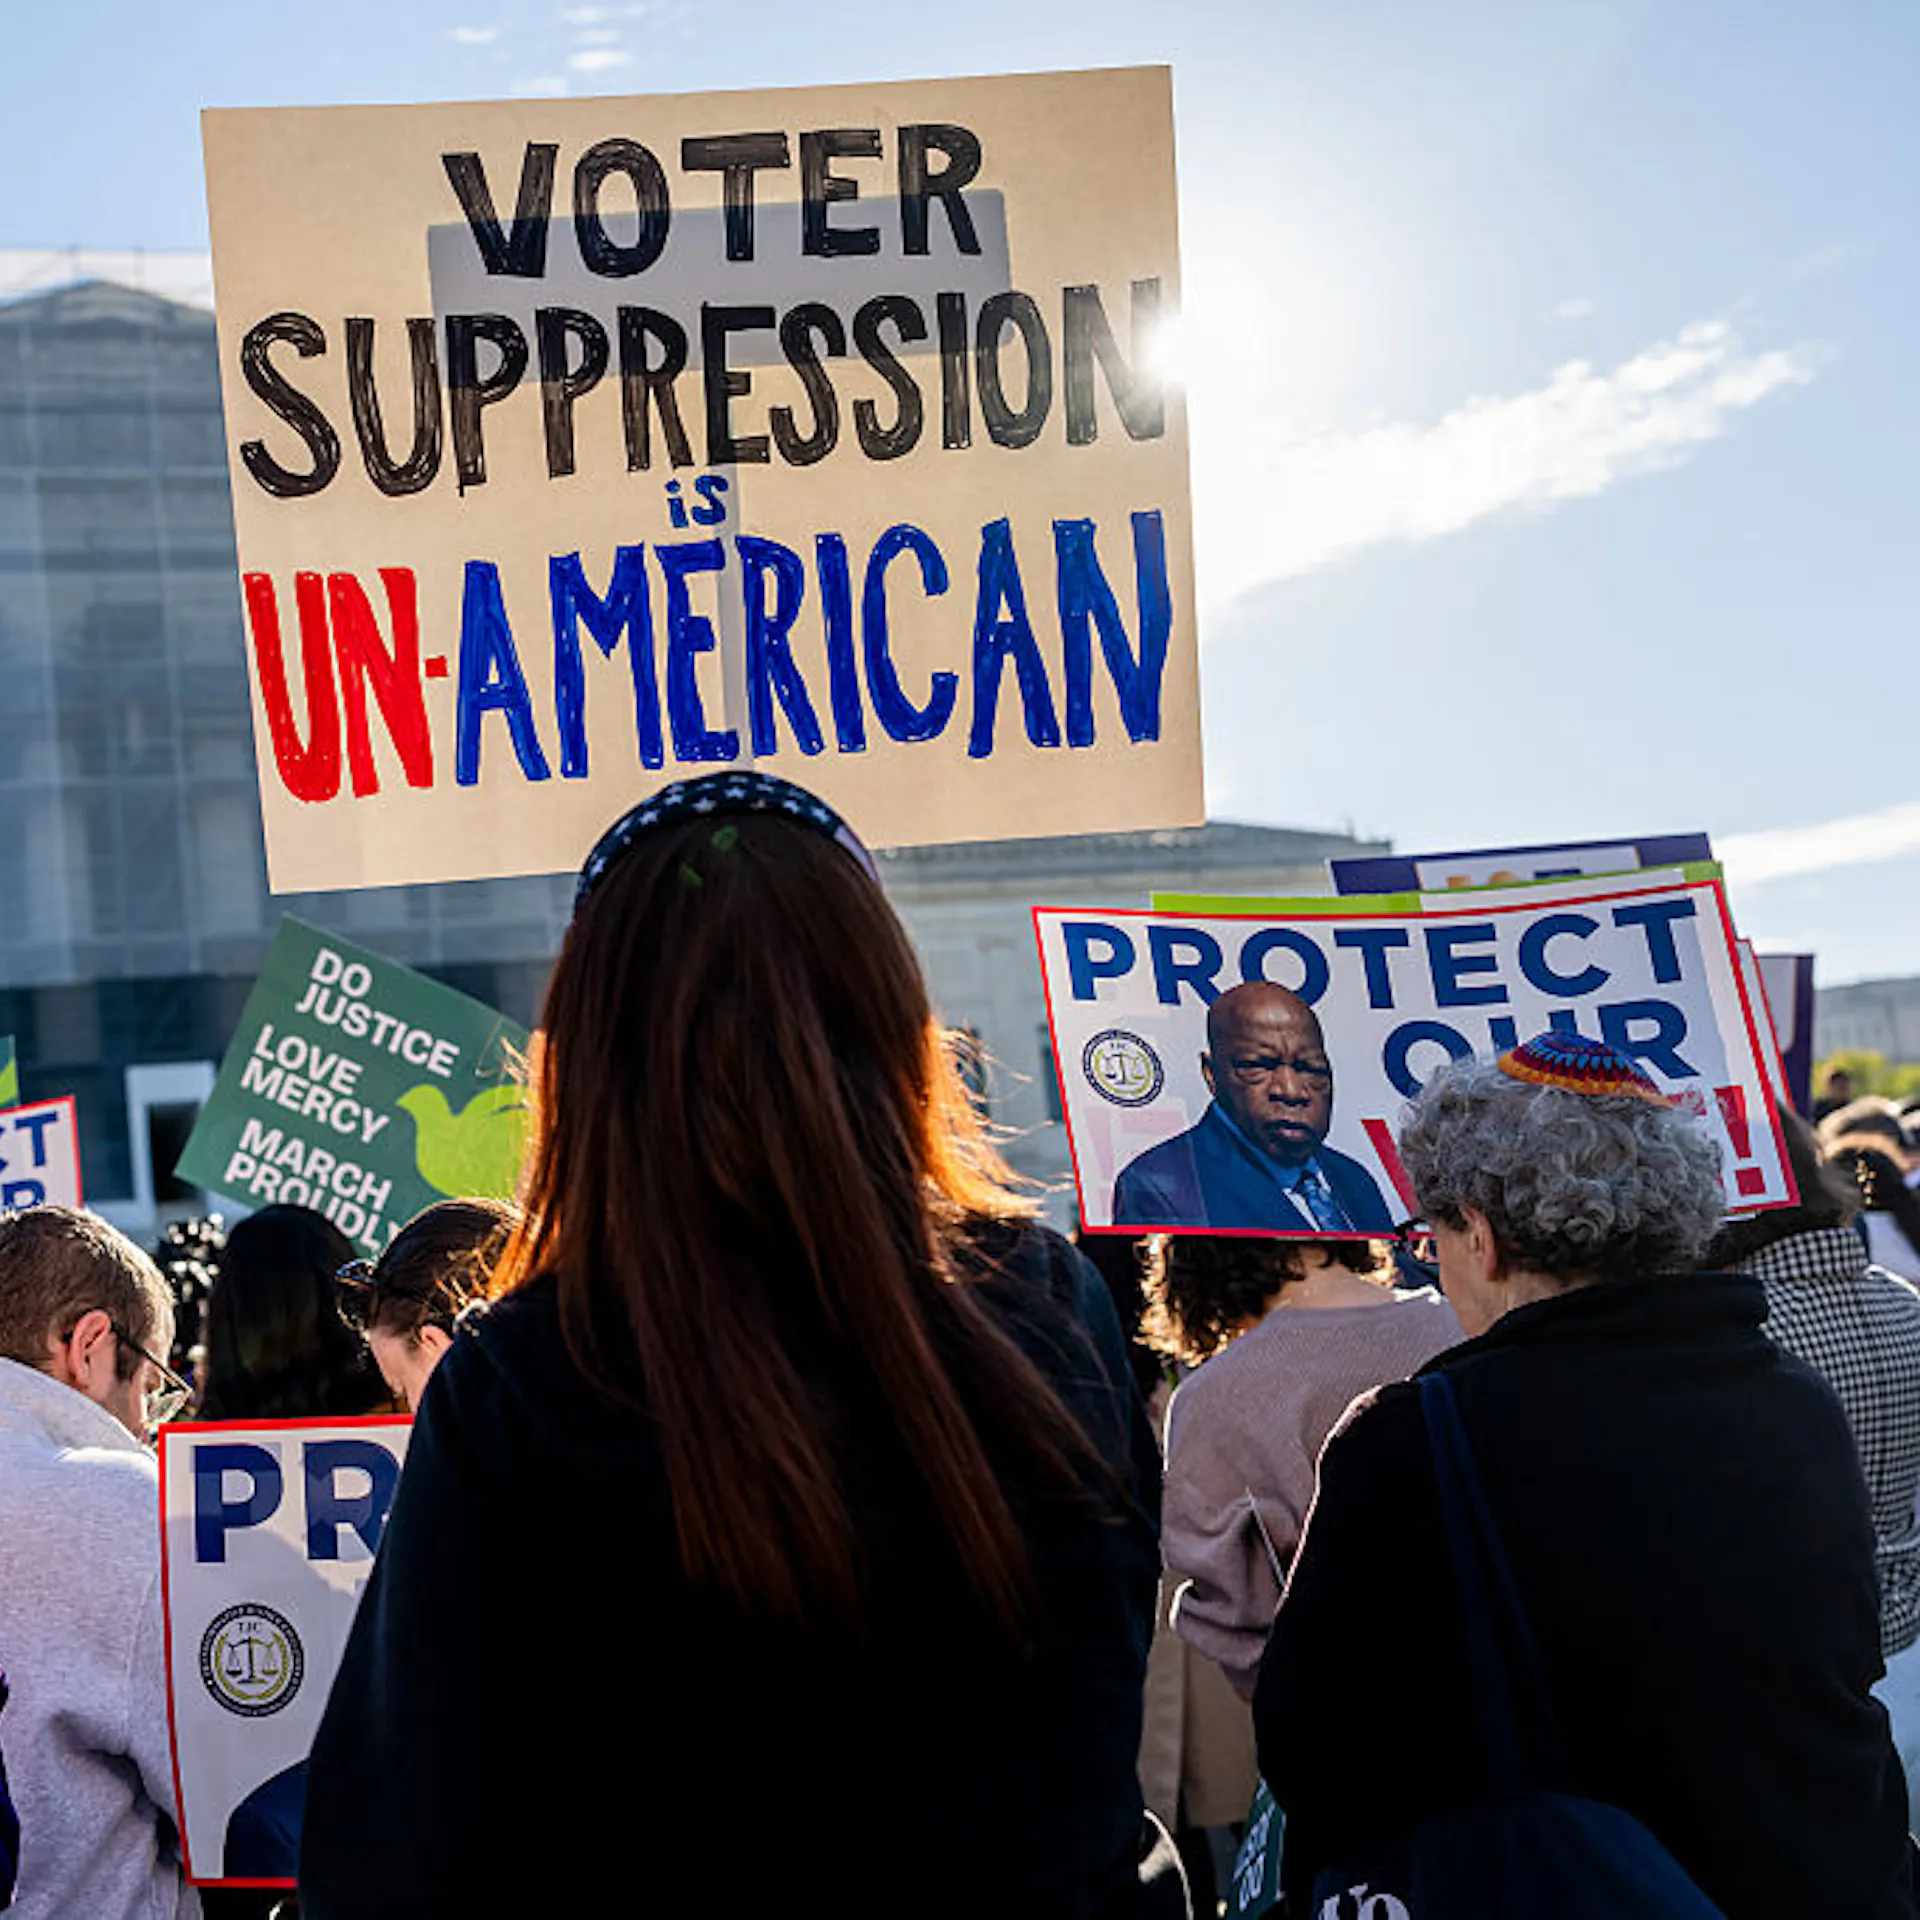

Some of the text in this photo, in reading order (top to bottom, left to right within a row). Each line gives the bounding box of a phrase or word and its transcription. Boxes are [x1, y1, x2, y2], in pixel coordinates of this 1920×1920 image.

[441, 123, 985, 279] VOTER
[239, 278, 1167, 500] SUPPRESSION
[665, 474, 730, 528] is
[243, 509, 1173, 803] UN-AMERICAN
[310, 948, 373, 998] DO
[1061, 897, 1697, 1010] PROTECT
[254, 1024, 364, 1096] LOVE
[295, 983, 462, 1078] JUSTICE
[240, 1057, 390, 1144] MERCY
[238, 1117, 393, 1212] MARCH
